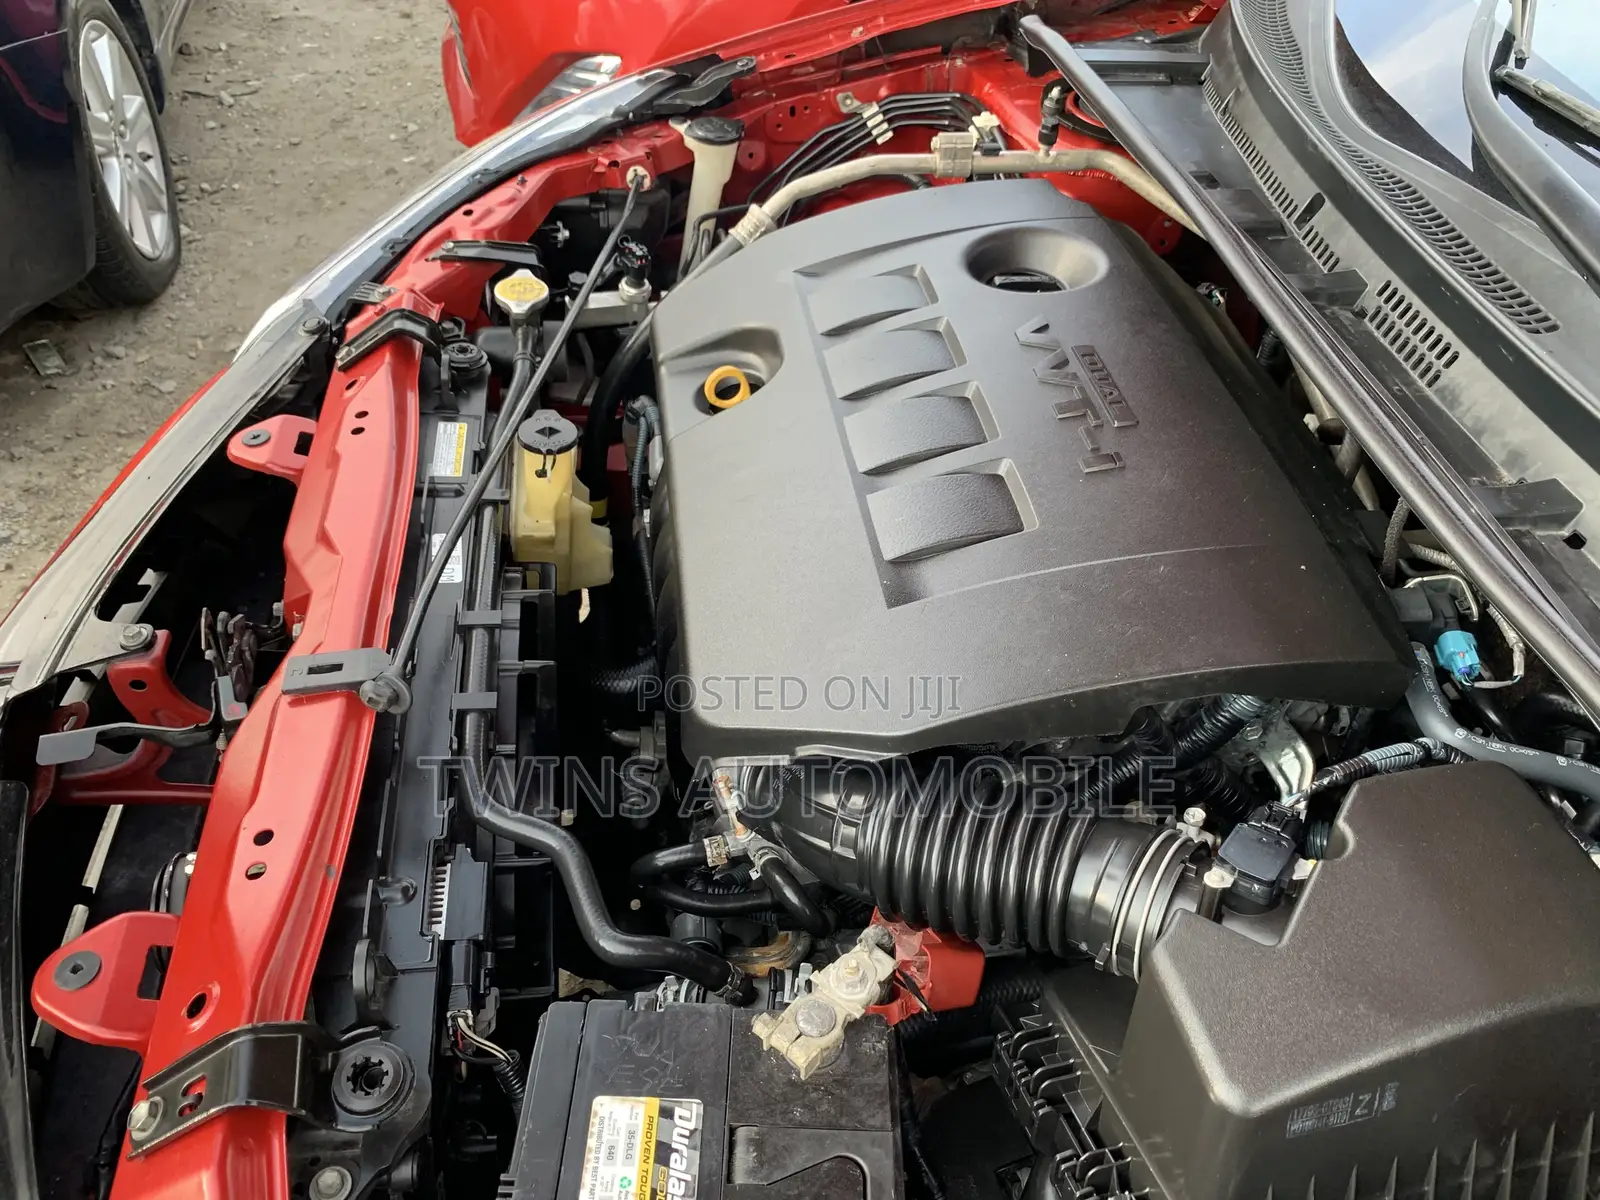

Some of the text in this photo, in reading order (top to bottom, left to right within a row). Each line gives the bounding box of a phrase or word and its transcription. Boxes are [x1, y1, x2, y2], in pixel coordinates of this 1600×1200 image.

[594, 1116, 606, 1154] DISTRIBUTED
[625, 1129, 636, 1160] 35-DLG
[643, 1115, 654, 1165] PROVEN
[593, 1156, 600, 1166] BY
[606, 1145, 616, 1160] 640
[590, 1166, 599, 1182] BEST
